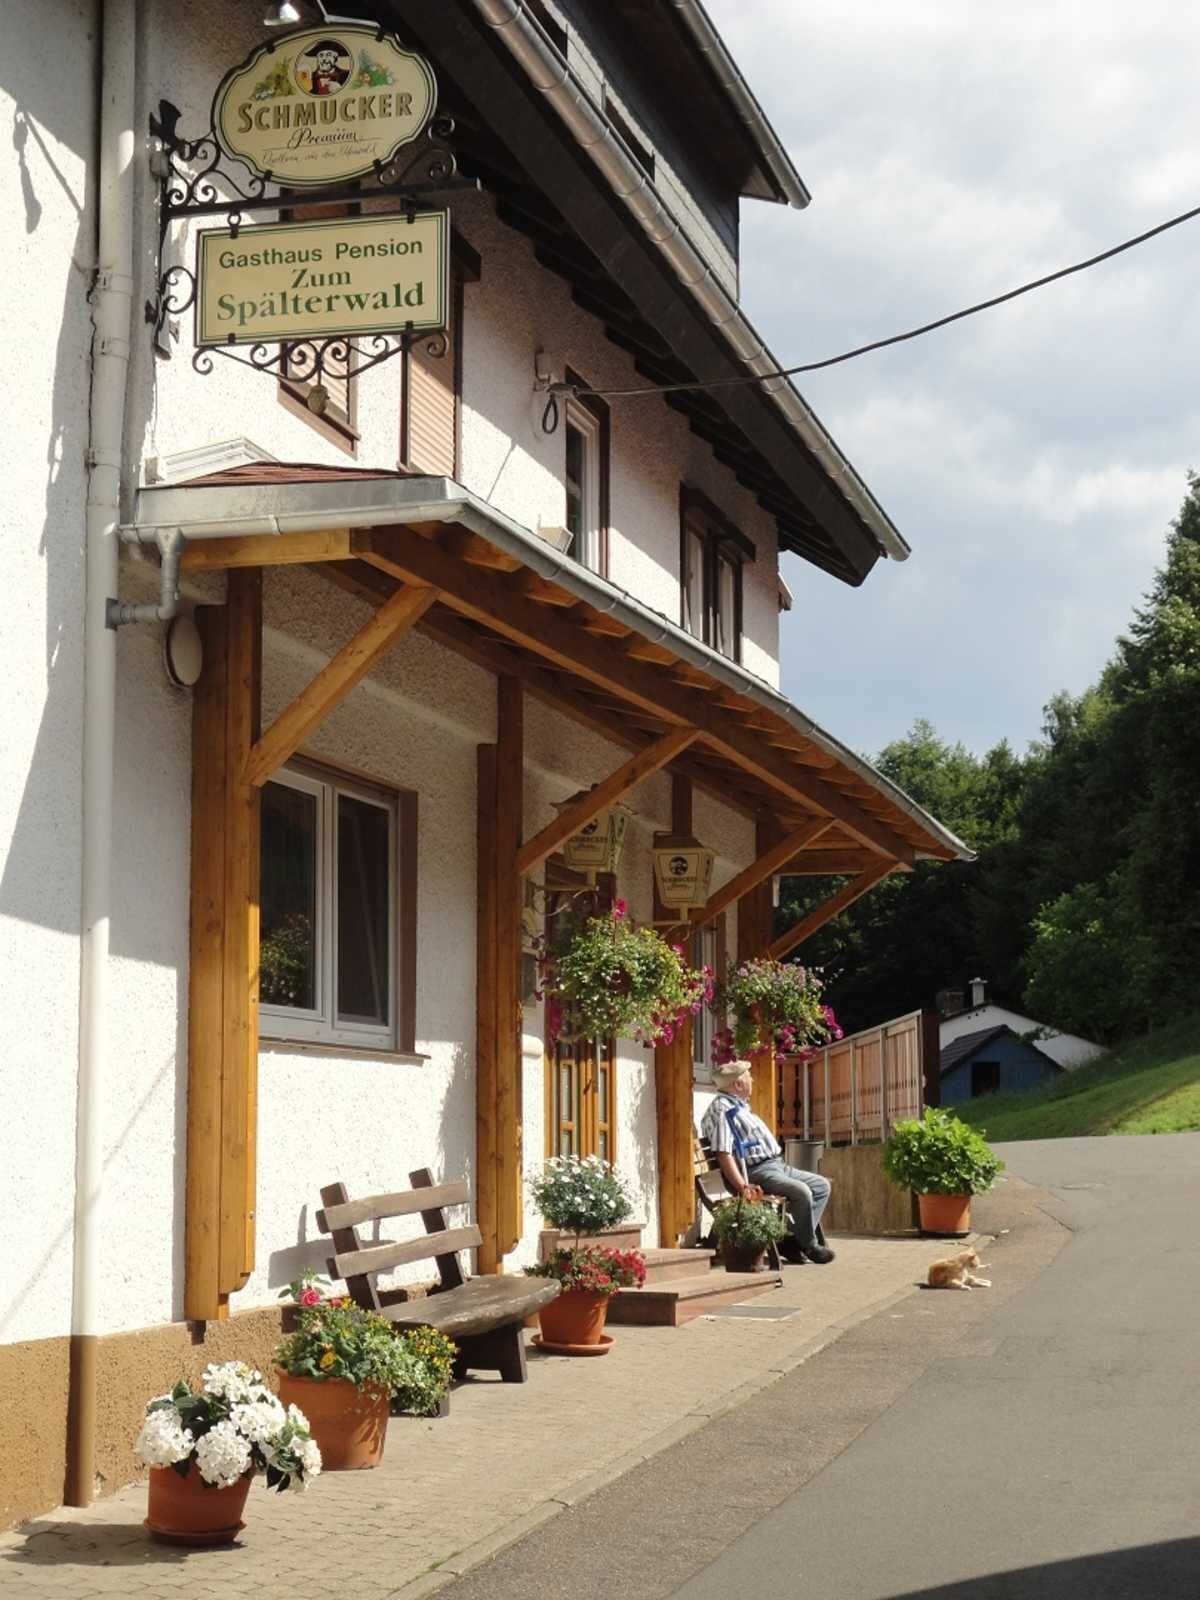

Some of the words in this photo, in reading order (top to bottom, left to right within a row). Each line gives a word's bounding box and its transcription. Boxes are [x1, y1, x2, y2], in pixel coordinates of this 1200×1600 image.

[237, 92, 413, 133] SCHMUCKER
[219, 248, 323, 269] Gasthaus
[335, 238, 423, 260] Pension
[291, 268, 352, 289] Zum
[216, 281, 425, 326] Spälterwald
